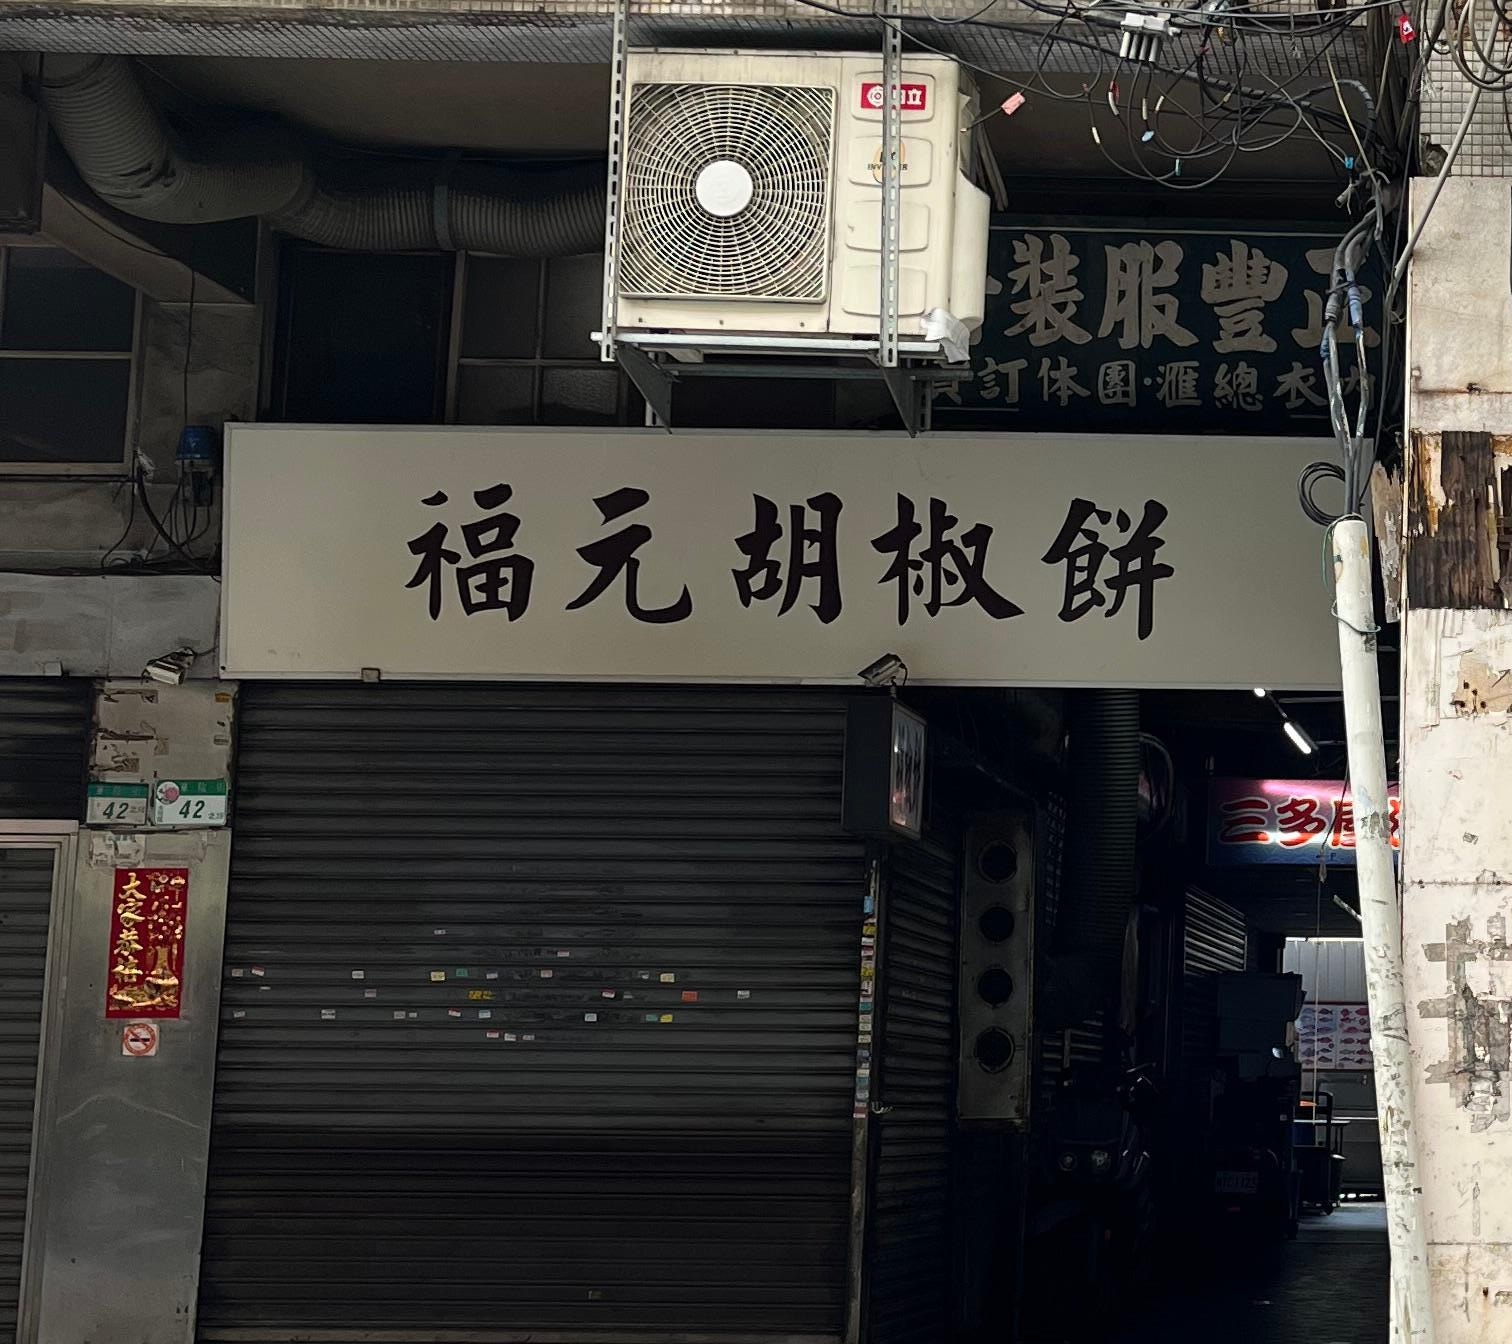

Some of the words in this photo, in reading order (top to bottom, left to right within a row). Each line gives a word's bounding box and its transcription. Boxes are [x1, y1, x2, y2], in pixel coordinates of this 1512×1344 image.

[970, 232, 1381, 354] 正豐服裝
[404, 483, 1176, 641] 福元胡椒餅
[103, 802, 129, 819] 42
[179, 800, 205, 819] 42
